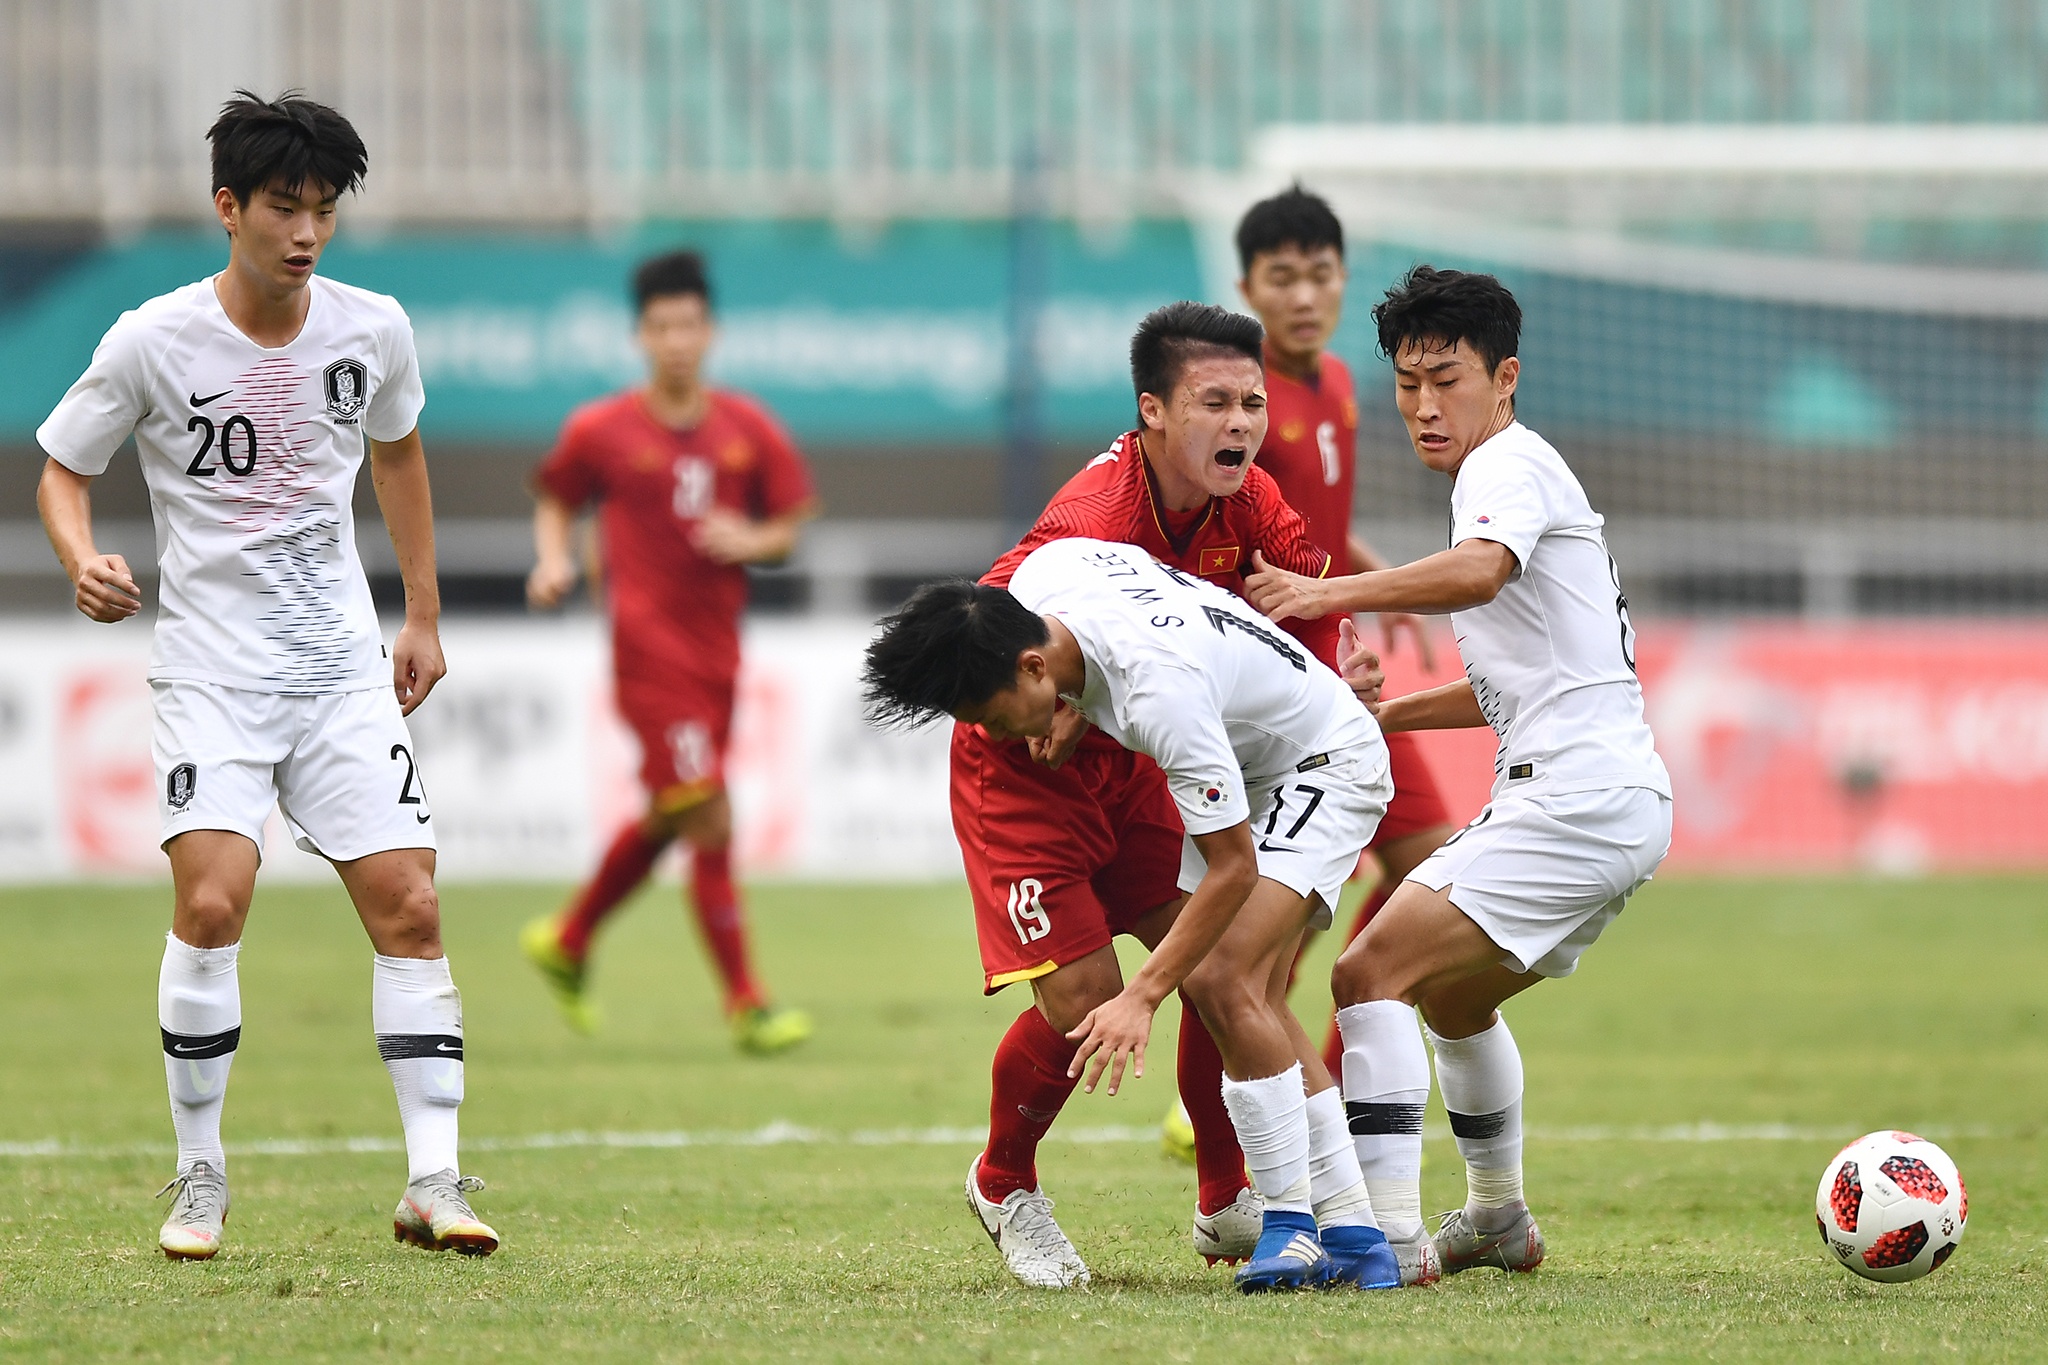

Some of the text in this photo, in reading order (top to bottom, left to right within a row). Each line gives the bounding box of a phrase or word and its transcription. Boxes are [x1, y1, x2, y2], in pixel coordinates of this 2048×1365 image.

[185, 414, 258, 477] 20
[1316, 421, 1341, 487] 6
[1081, 551, 1185, 628] S W LEE
[390, 743, 429, 805] 2
[1264, 783, 1326, 840] 17
[1007, 877, 1052, 946] 19
